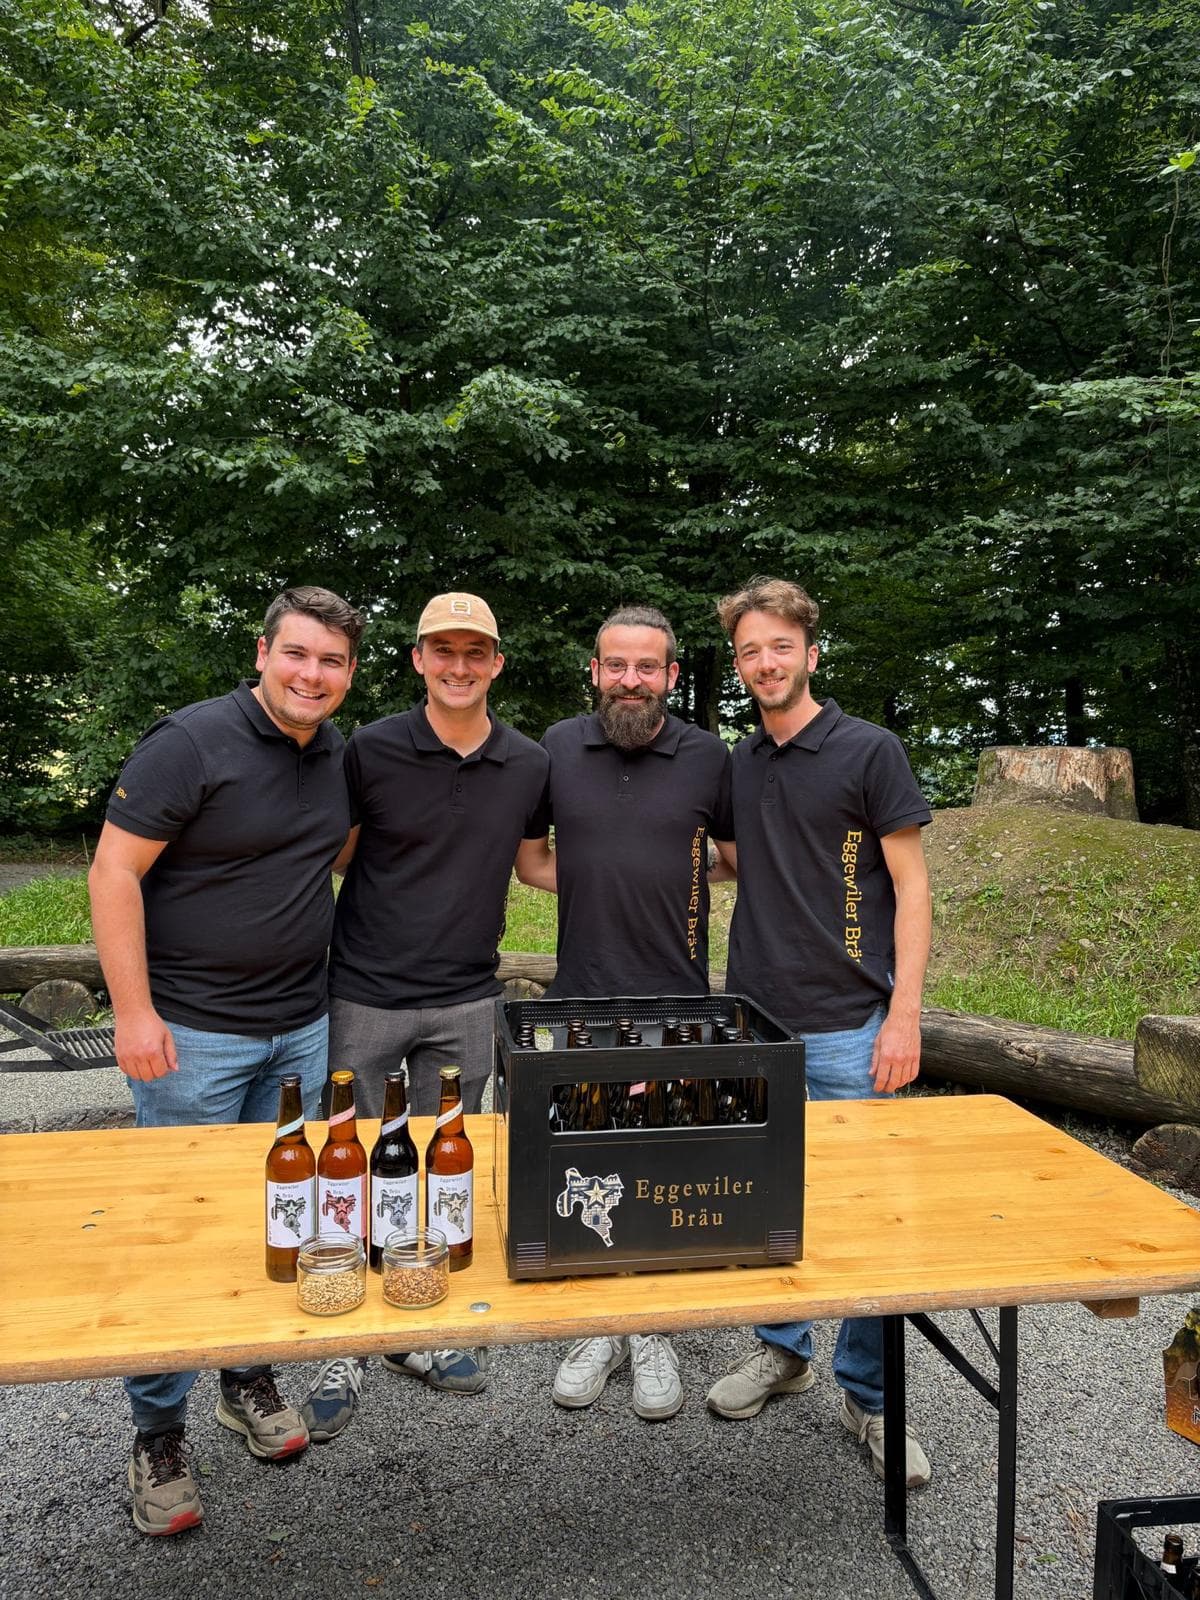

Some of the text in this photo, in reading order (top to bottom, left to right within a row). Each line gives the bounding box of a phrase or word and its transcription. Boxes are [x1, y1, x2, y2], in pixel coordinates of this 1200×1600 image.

[841, 830, 863, 966] Eggewiler Brä
[635, 1175, 754, 1204] Eggewiler
[670, 1208, 724, 1228] Bräu
